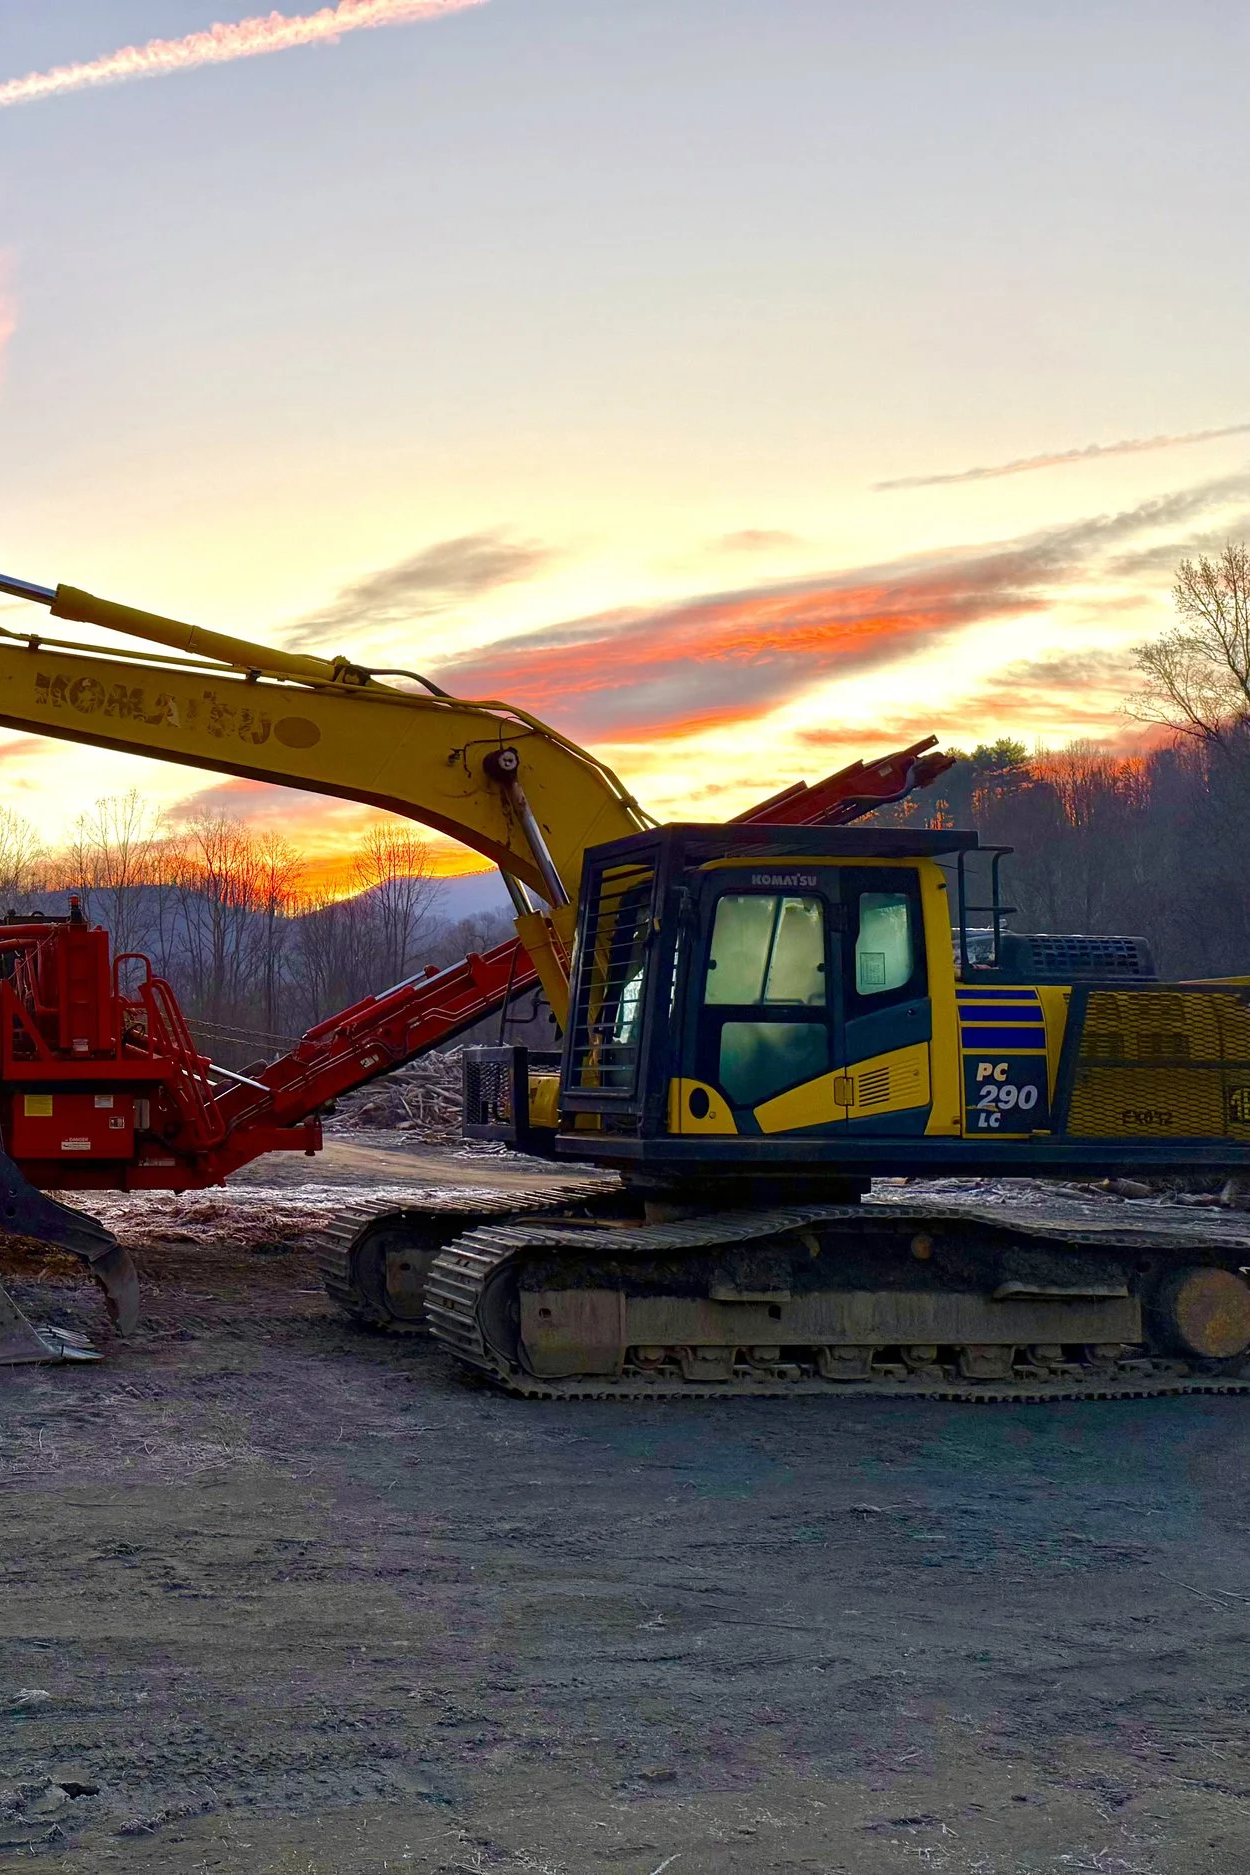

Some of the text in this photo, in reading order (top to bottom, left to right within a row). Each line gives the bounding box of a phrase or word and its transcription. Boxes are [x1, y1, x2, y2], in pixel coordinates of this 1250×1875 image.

[751, 873, 817, 886] KOMATSU
[976, 1062, 1009, 1081] PC
[977, 1085, 1038, 1110] 290
[978, 1112, 1001, 1128] LC
